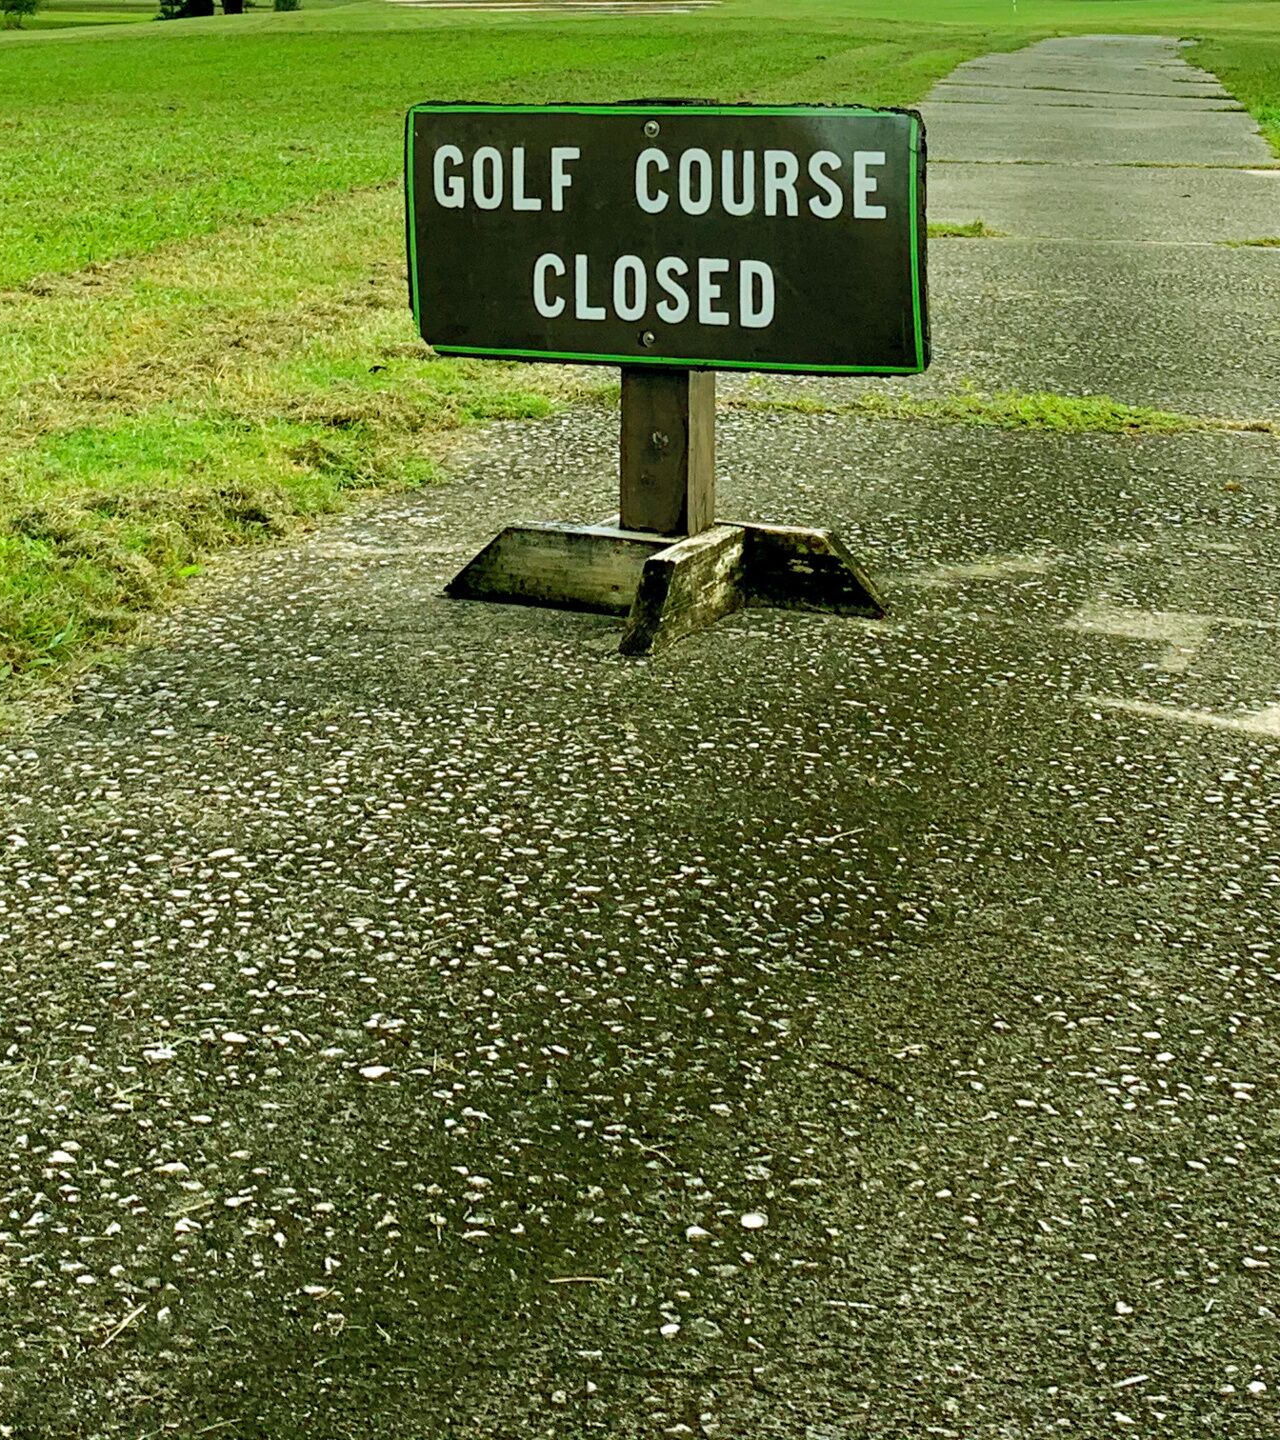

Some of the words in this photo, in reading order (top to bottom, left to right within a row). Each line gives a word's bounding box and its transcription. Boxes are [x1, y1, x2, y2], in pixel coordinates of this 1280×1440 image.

[433, 144, 581, 211] GOLF
[635, 147, 887, 219] COURSE
[533, 253, 775, 328] CLOSED
